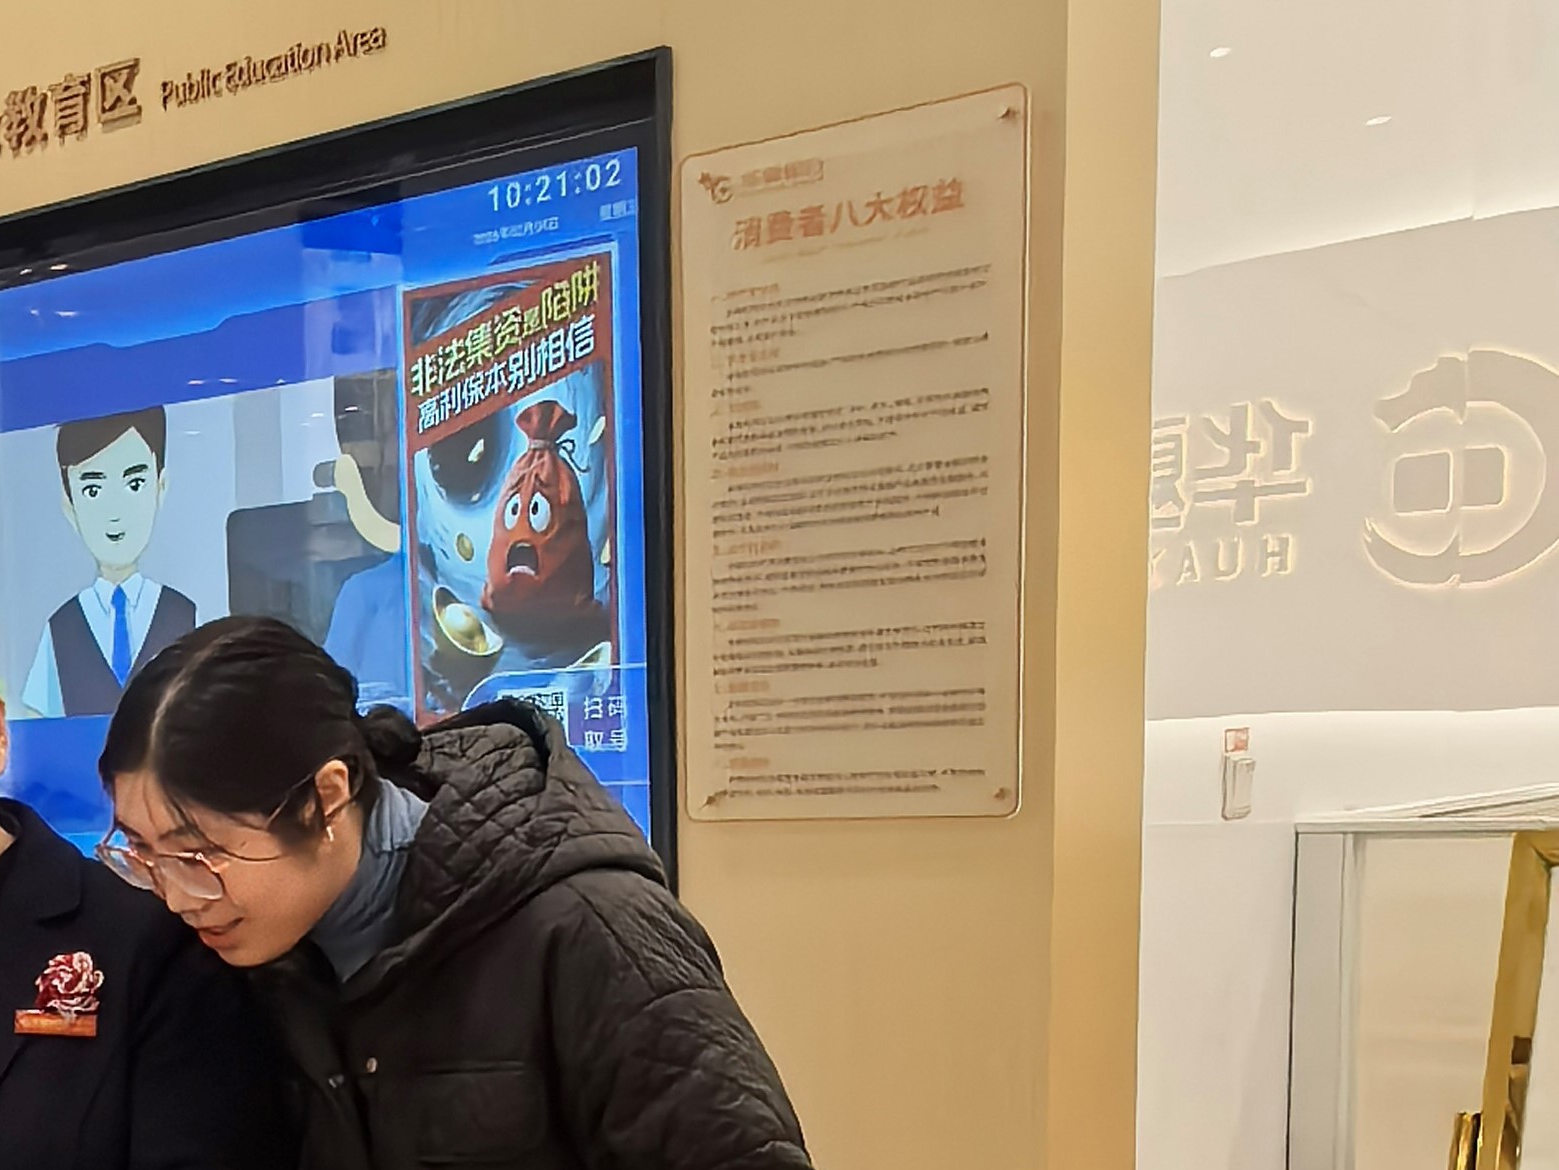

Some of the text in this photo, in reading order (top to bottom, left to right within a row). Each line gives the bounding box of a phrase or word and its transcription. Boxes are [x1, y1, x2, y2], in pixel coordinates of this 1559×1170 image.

[160, 25, 387, 111] Public Education Area
[488, 158, 622, 212] 10:21:02
[732, 177, 965, 251] 消费者八大权益
[409, 260, 601, 397] 非法集资是陷阱
[417, 313, 596, 435] 高利保本别相信
